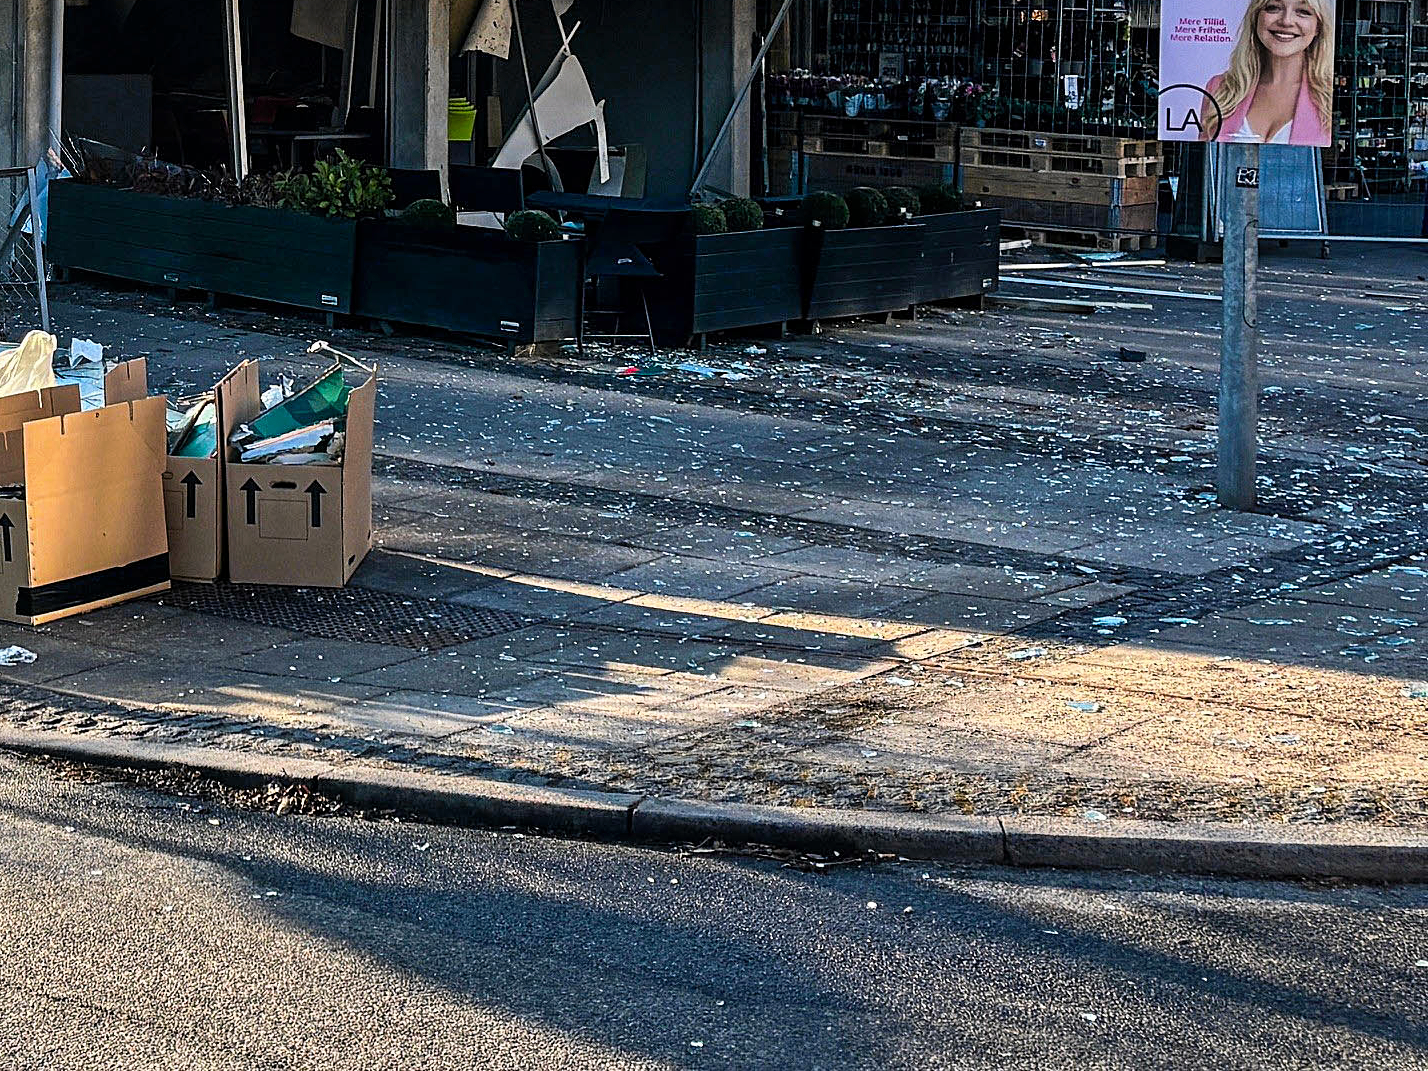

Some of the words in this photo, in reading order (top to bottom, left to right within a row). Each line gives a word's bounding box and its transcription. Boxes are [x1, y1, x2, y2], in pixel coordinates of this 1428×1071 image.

[1179, 18, 1201, 26] Mere
[1174, 26, 1197, 34] Mere
[1170, 34, 1193, 42] Mere
[1165, 107, 1204, 133] LA
